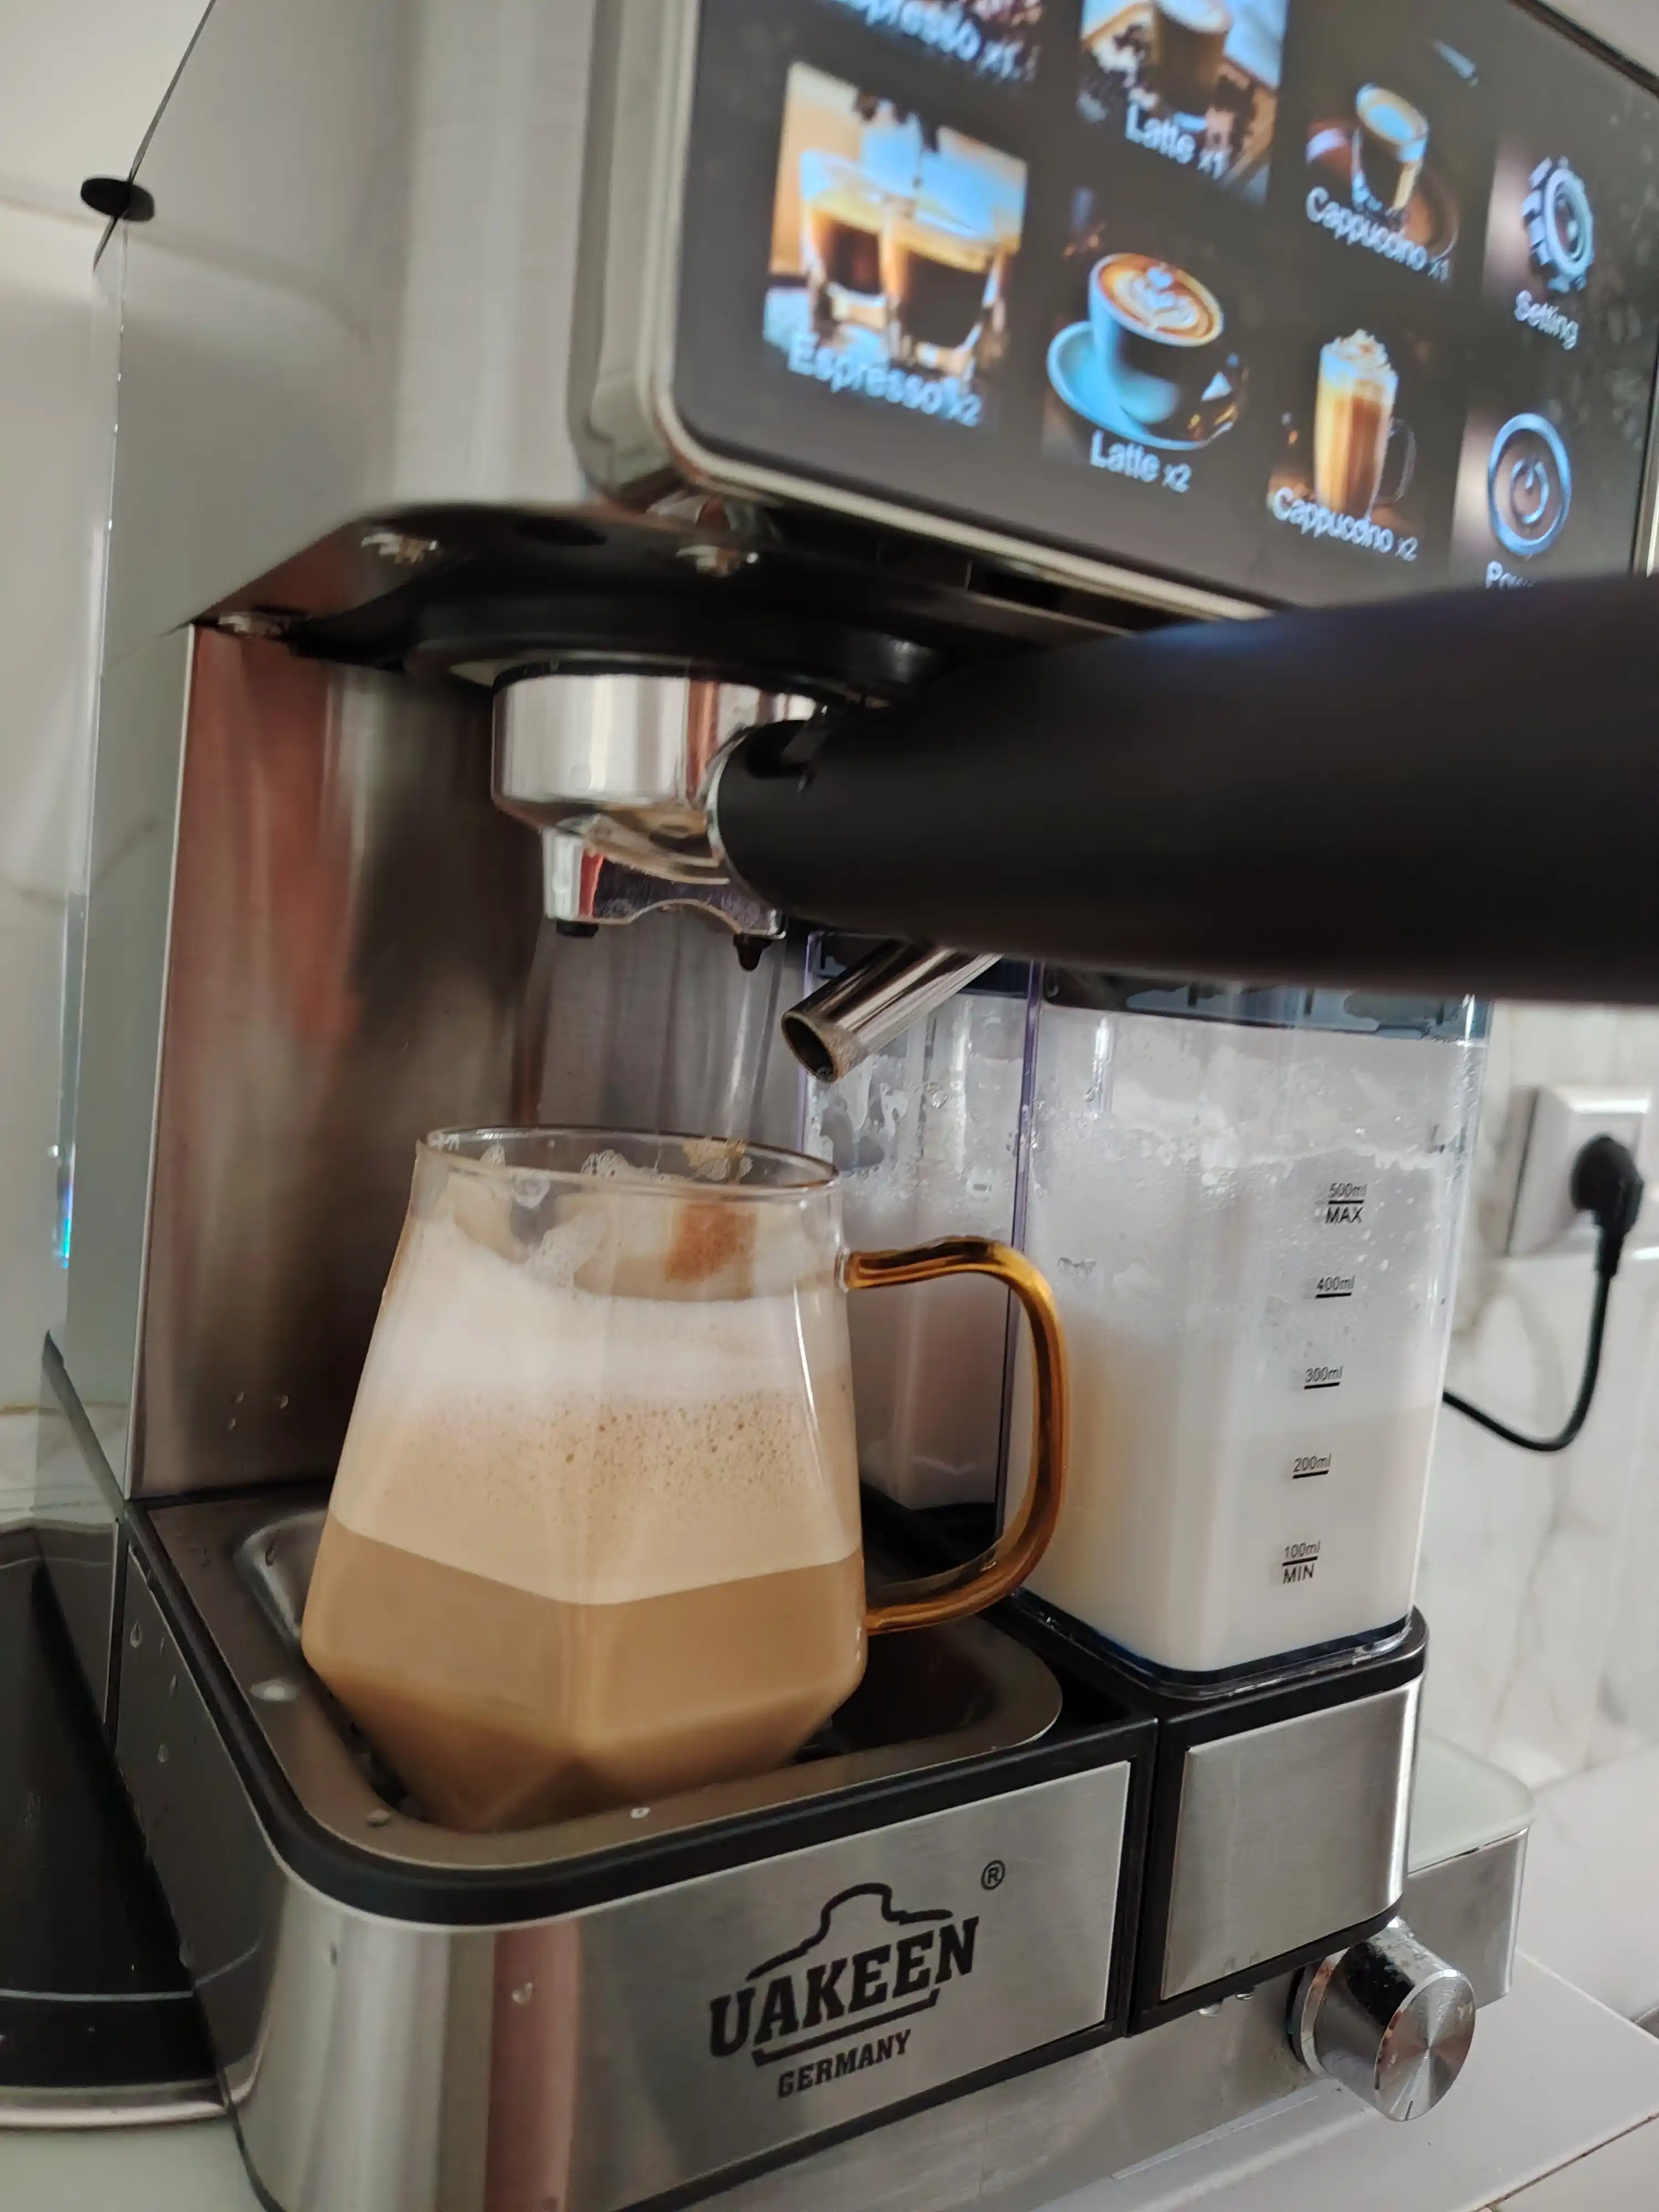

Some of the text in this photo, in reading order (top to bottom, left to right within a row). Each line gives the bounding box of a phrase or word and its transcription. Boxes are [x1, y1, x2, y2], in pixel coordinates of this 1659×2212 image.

[1125, 103, 1196, 164] Latte
[1306, 186, 1427, 271] Cappuccino
[1514, 290, 1579, 350] Setting
[787, 332, 942, 415] Espresso
[1090, 429, 1192, 493] Latte x2
[1272, 486, 1418, 561] Cappuccino x2
[1325, 1206, 1364, 1224] MAX
[1328, 1183, 1367, 1198] 500ml
[1316, 1275, 1355, 1292] 400ml
[1305, 1365, 1344, 1383] 300ml
[1293, 1453, 1332, 1473] 200ml
[1282, 1563, 1315, 1584] MIN
[1284, 1540, 1321, 1559] 100ml
[708, 1916, 979, 2058] UAKEEN
[777, 2028, 911, 2099] GERMANY
